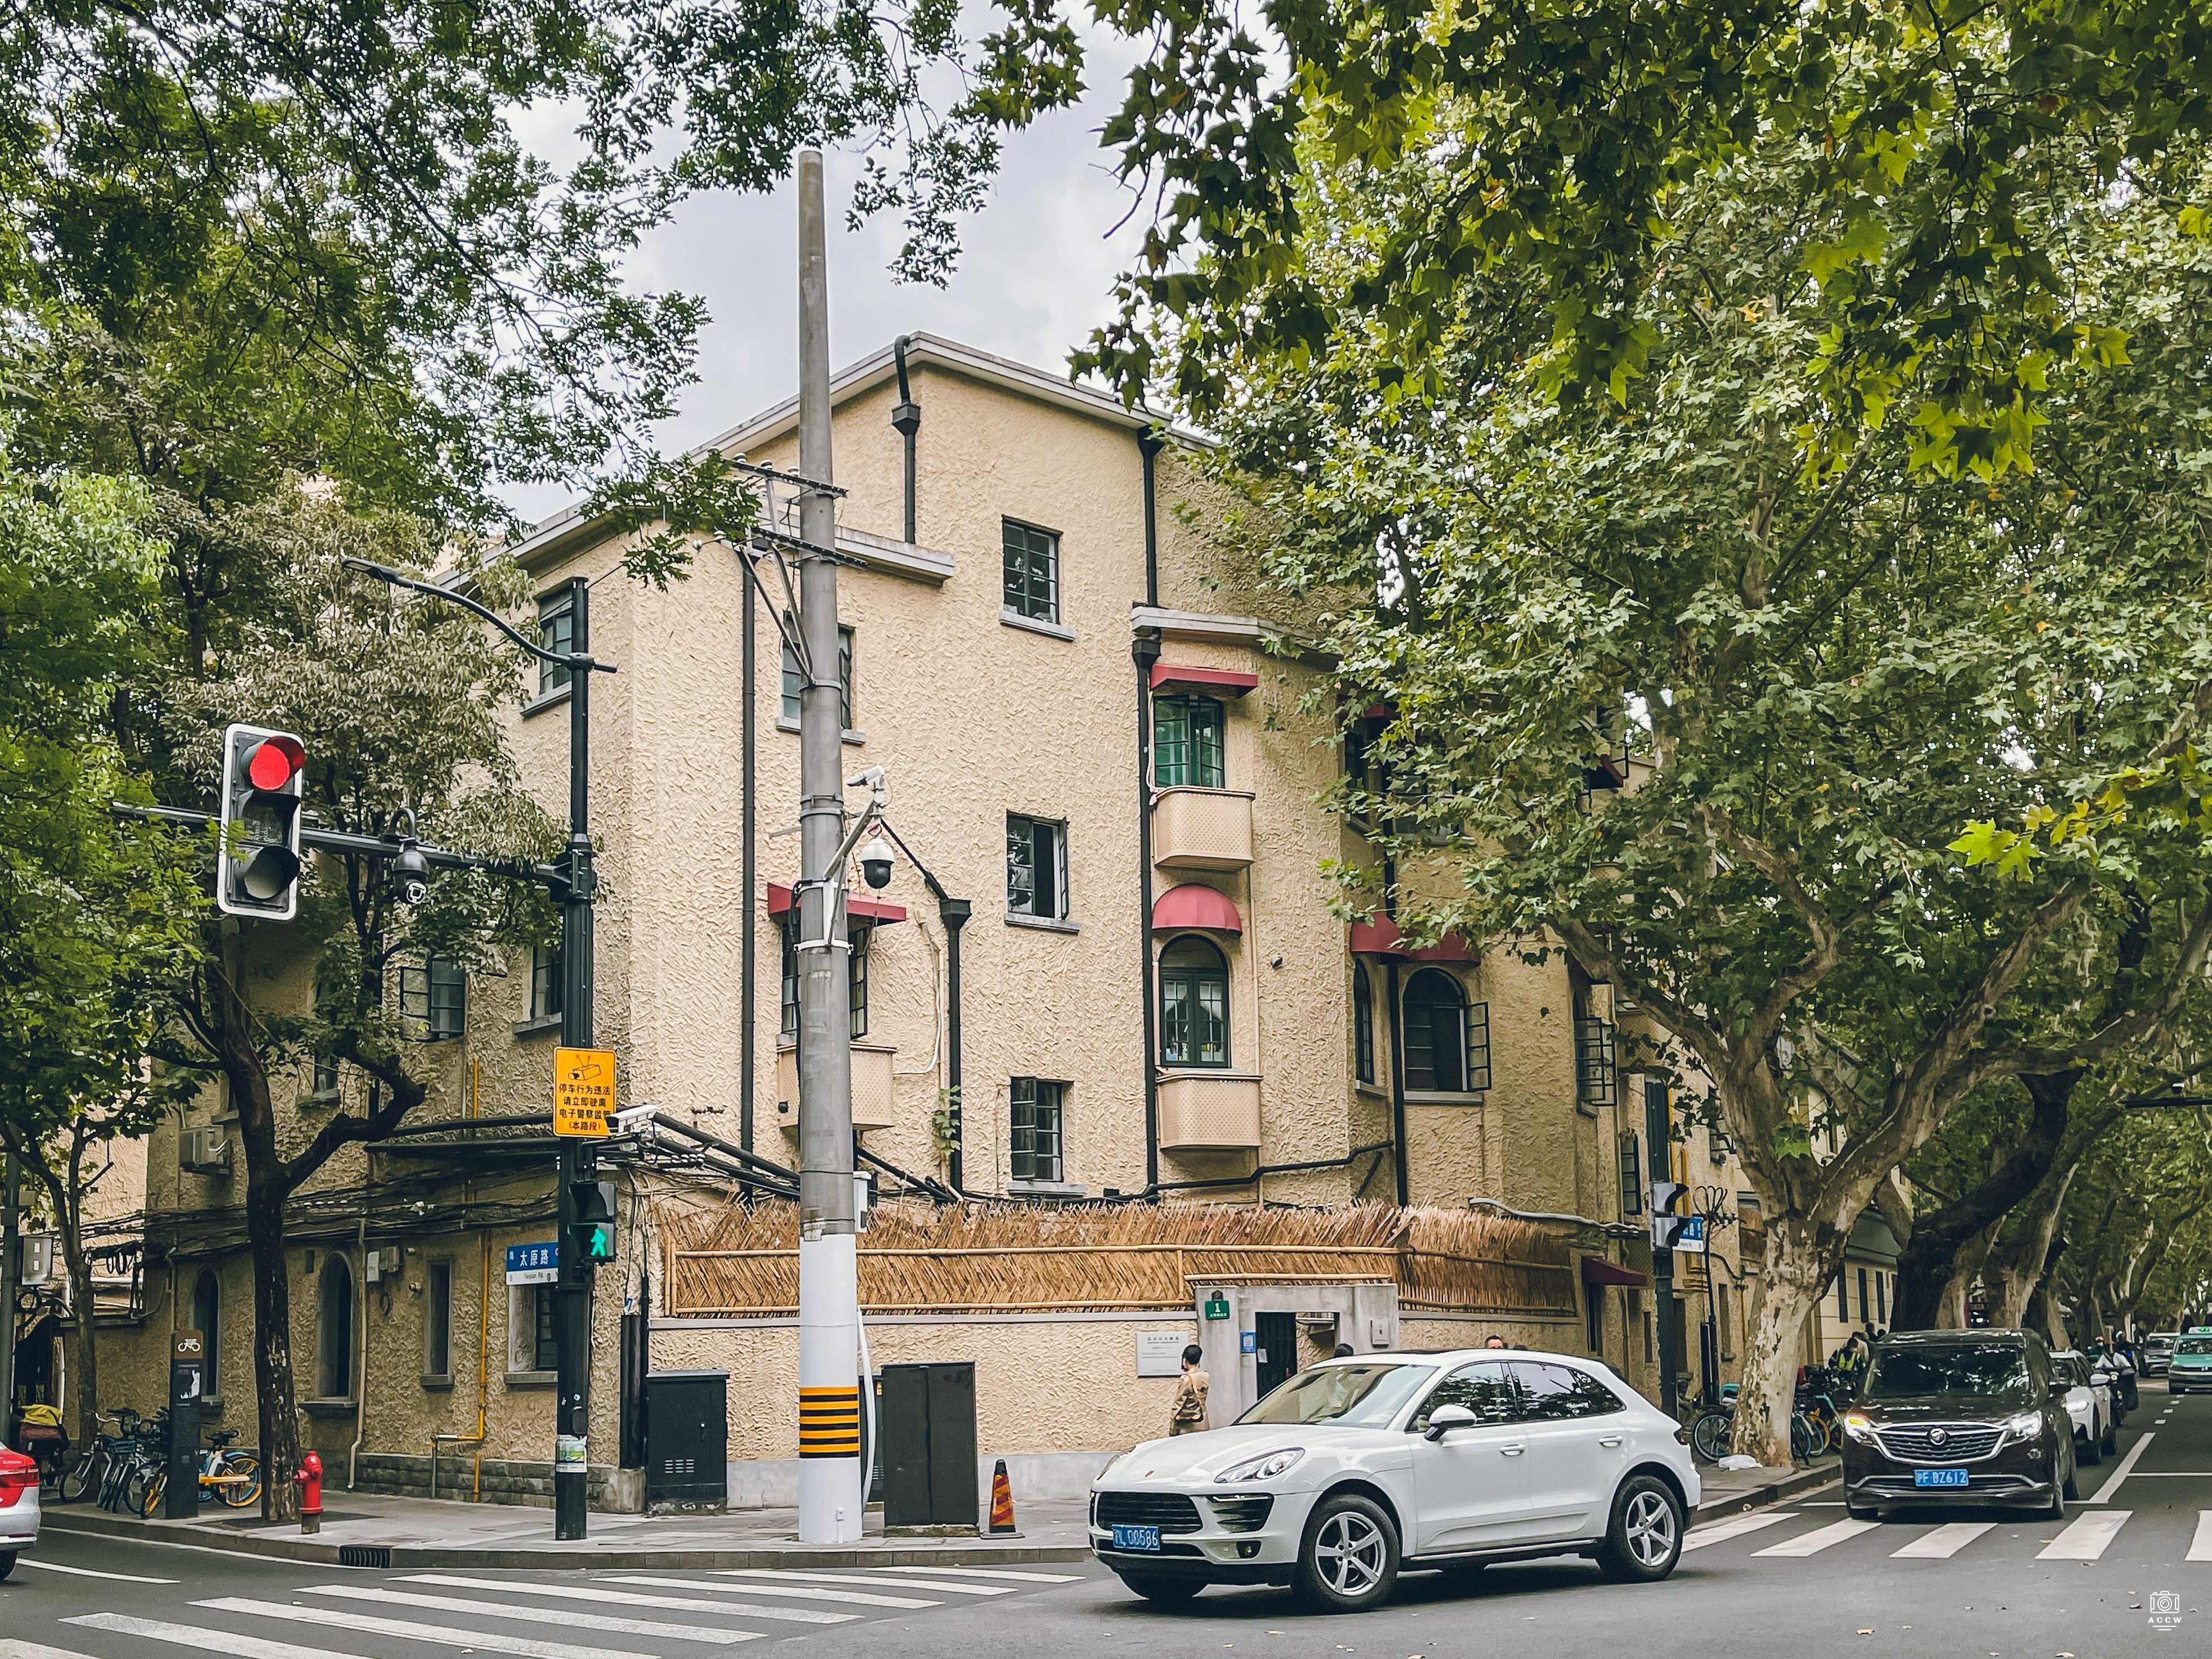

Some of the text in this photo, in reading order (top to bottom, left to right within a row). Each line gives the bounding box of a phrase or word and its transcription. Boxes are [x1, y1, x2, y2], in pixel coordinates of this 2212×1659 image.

[559, 1084, 611, 1095] 停车行为违法
[564, 1097, 606, 1107] 请立即驶离
[520, 1249, 549, 1267] 太原路
[1215, 1303, 1221, 1312] 1
